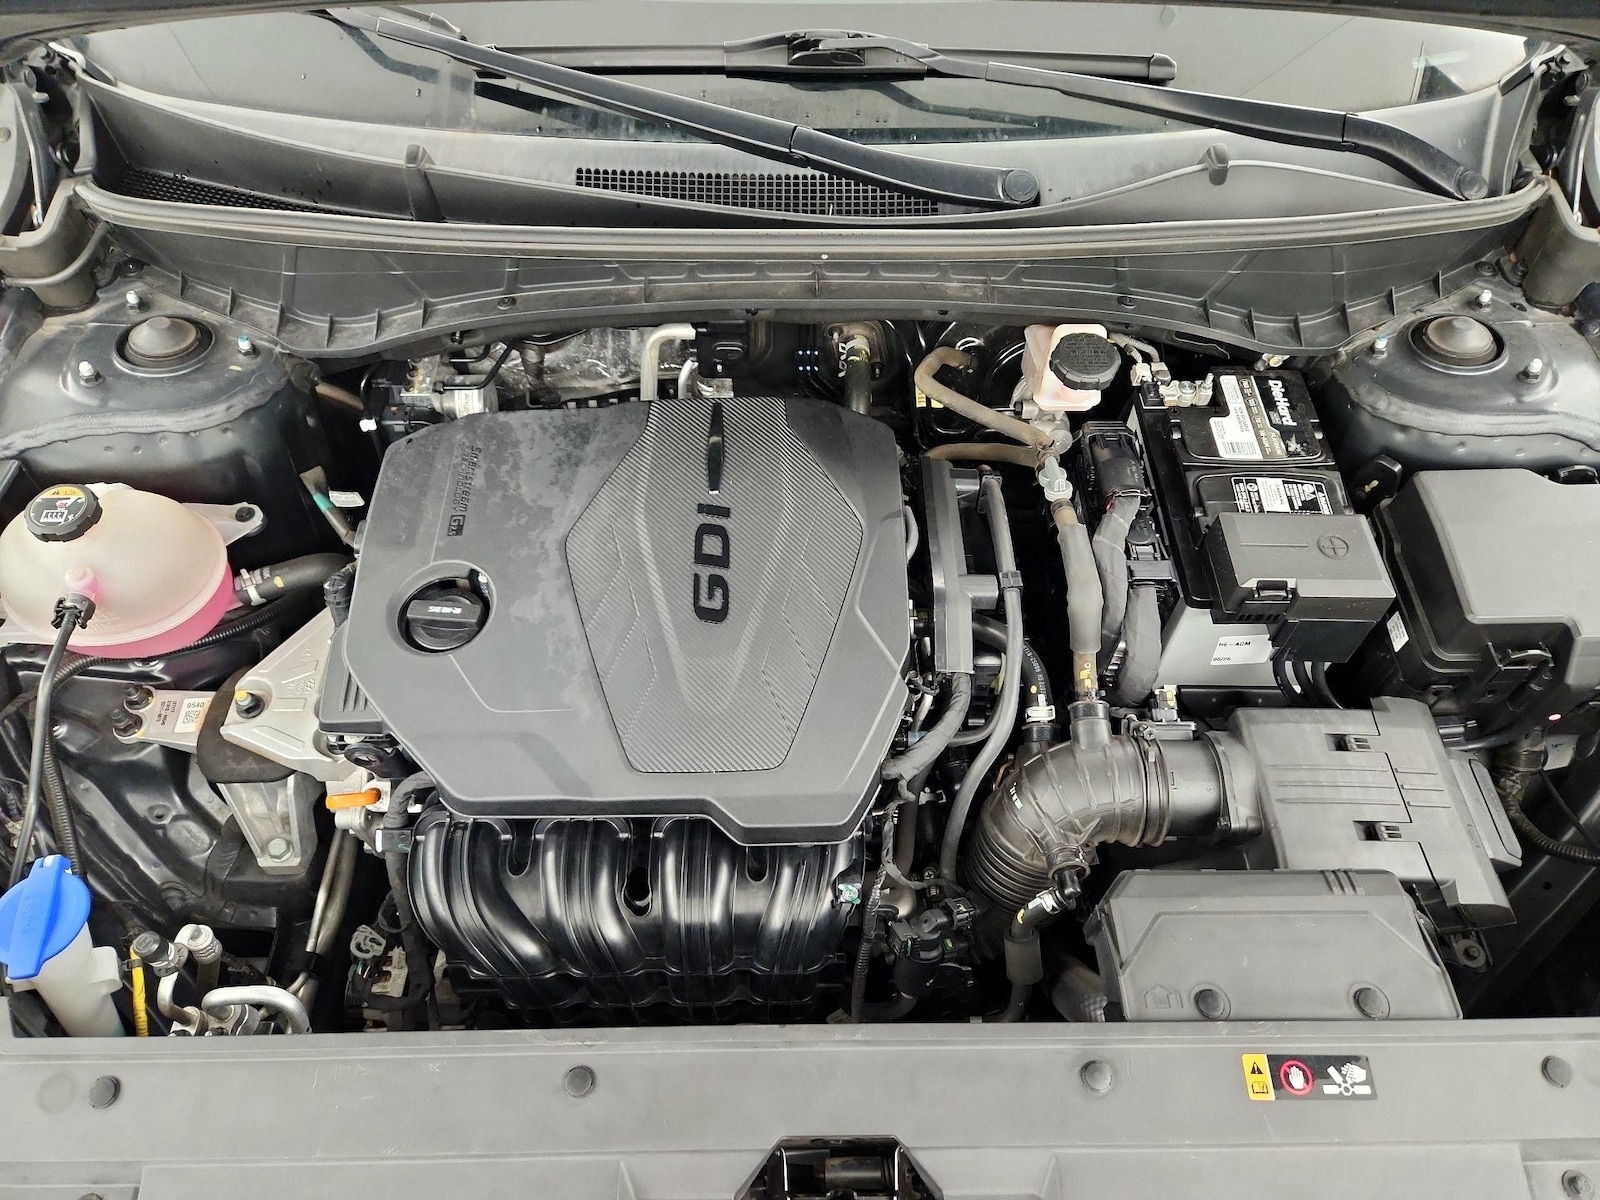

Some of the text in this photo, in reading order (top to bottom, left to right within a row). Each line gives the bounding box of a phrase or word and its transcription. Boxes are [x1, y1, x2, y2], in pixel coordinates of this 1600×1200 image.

[1268, 380, 1298, 426] DieHard
[453, 452, 469, 511] TECHNOLOGY
[459, 446, 482, 512] Smartstream
[693, 503, 731, 623] GDI
[186, 701, 205, 709] 9540
